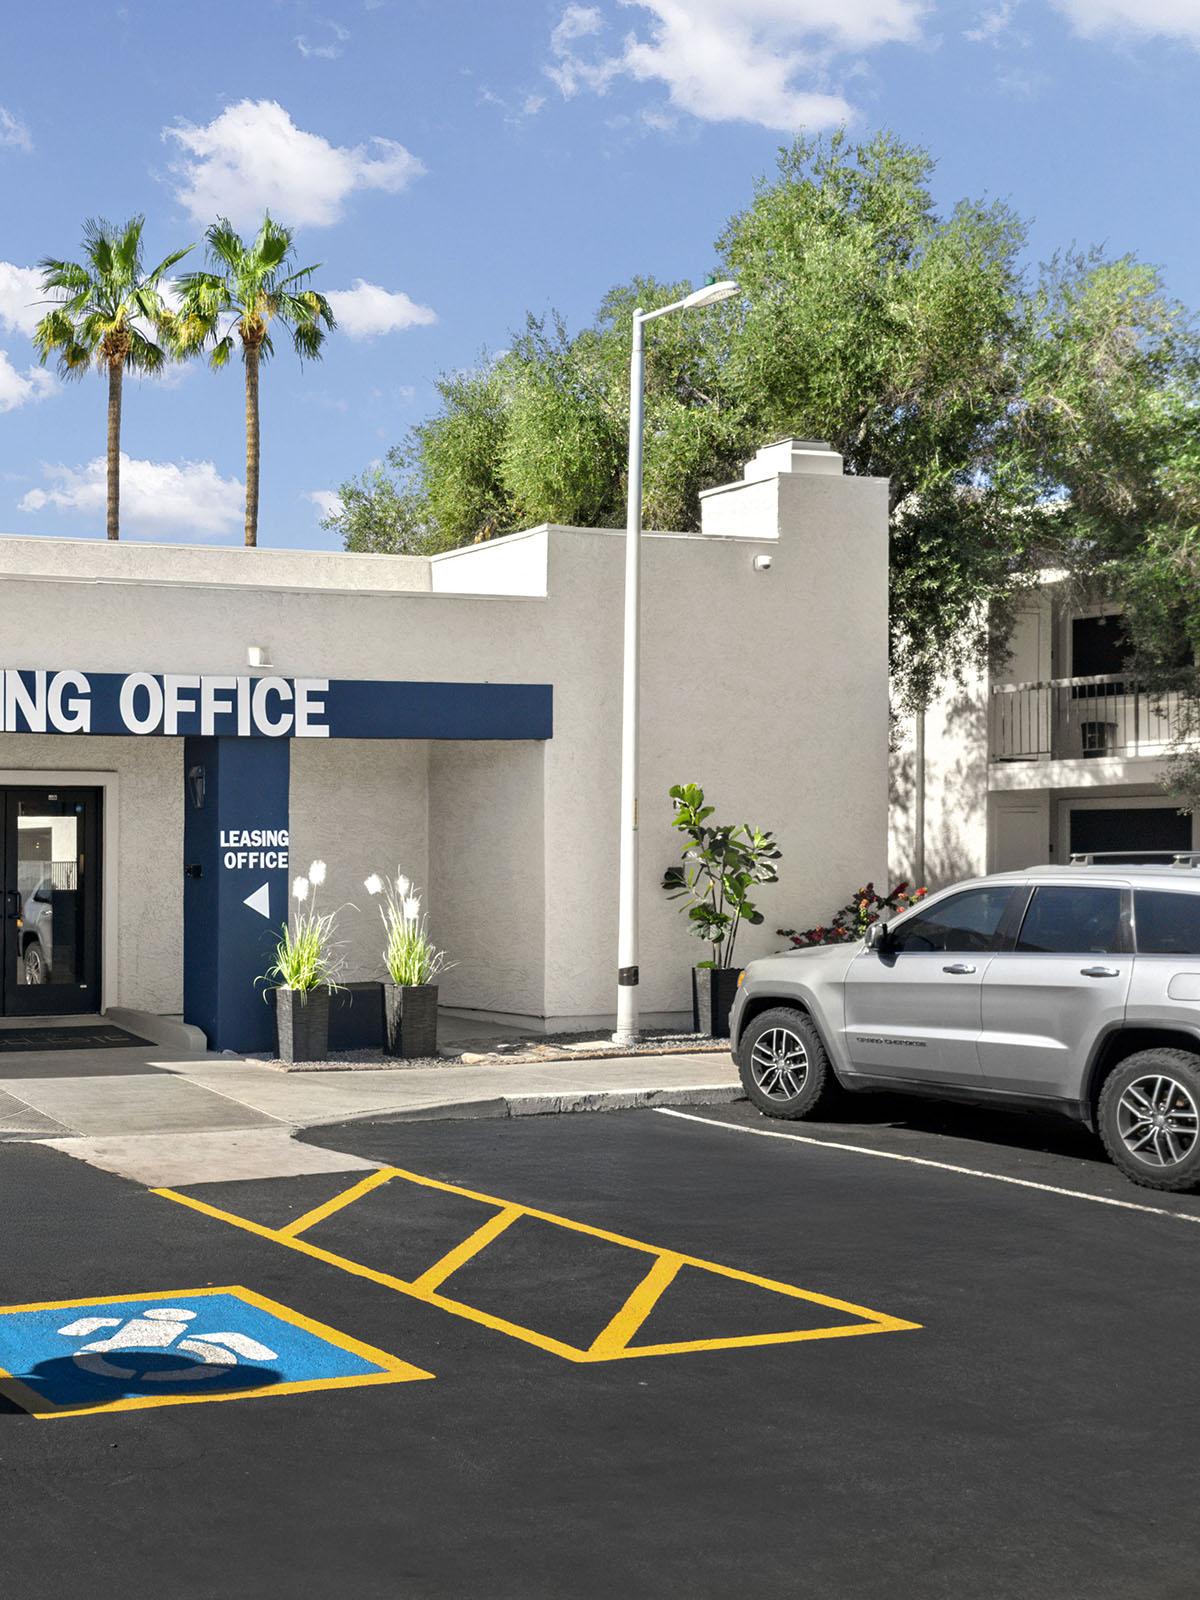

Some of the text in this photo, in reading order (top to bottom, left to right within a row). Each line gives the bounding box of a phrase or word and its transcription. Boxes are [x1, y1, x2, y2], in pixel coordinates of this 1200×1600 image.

[119, 671, 330, 738] OFFICE
[220, 830, 289, 848] LEASING
[224, 852, 289, 869] OFFICE
